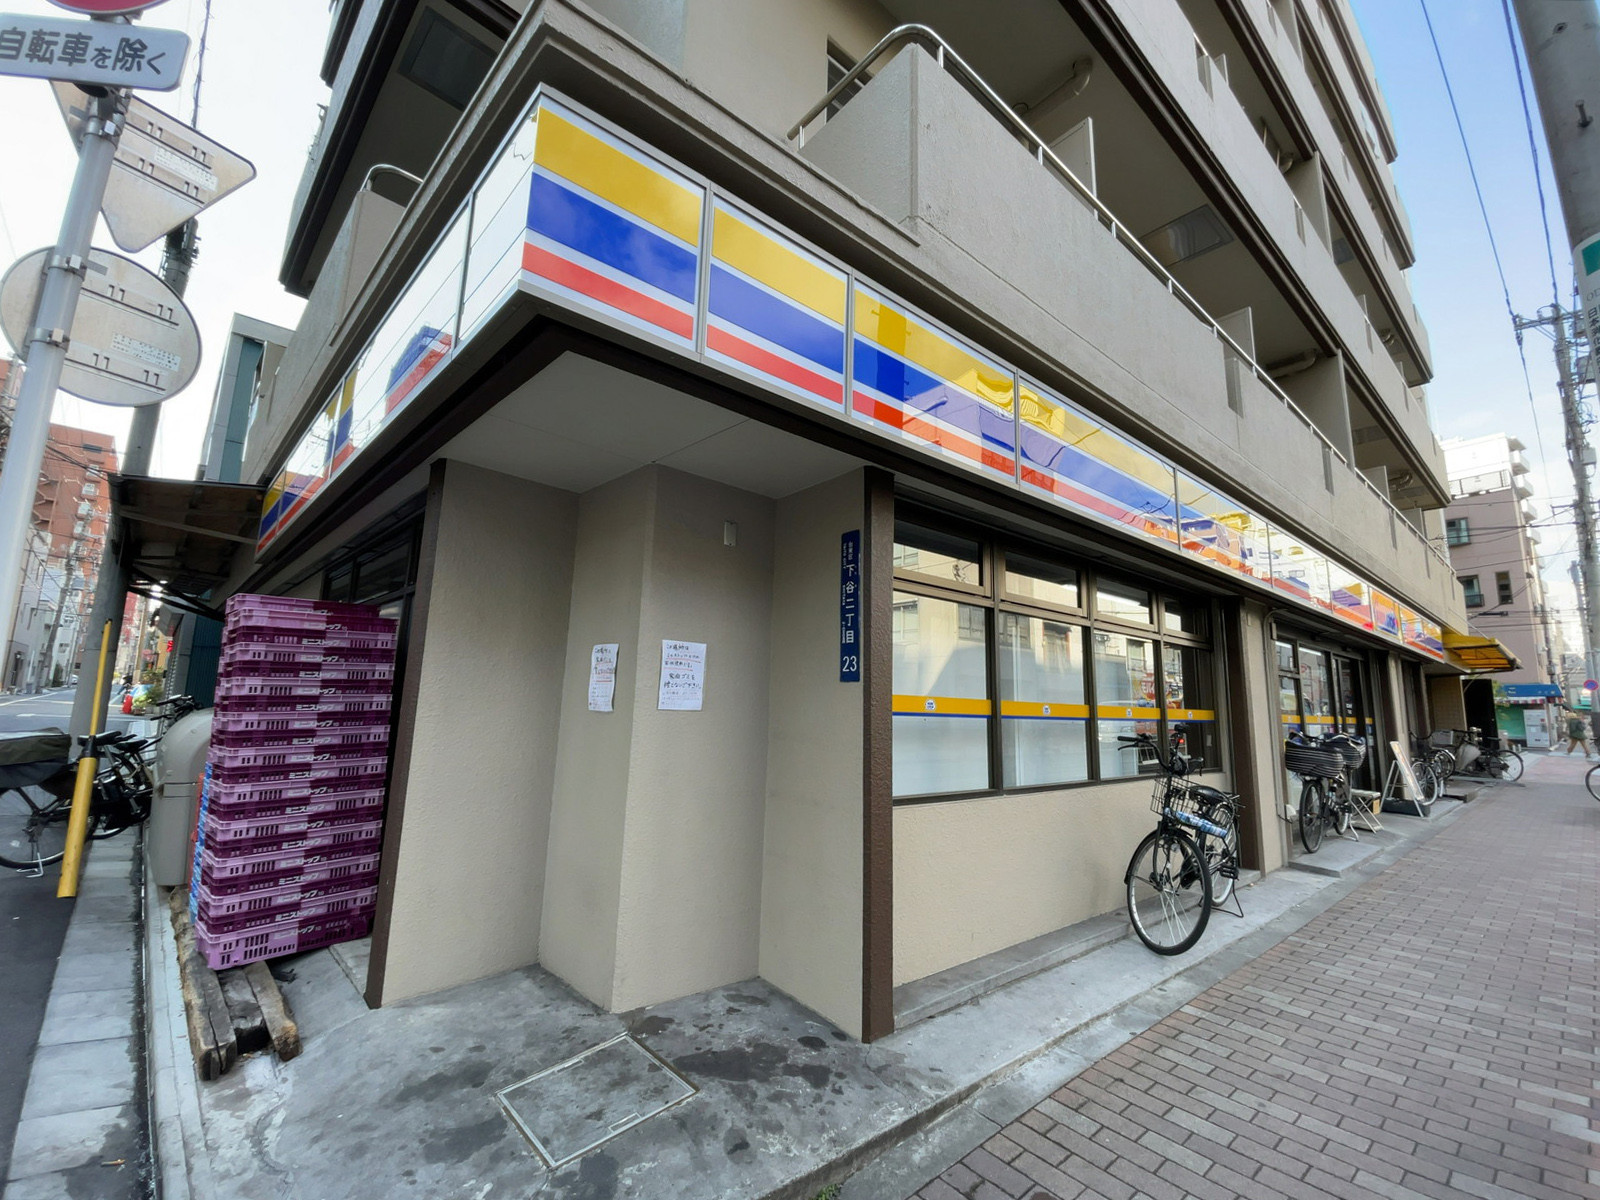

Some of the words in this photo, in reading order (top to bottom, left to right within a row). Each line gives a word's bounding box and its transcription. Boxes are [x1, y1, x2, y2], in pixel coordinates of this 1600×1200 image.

[0, 27, 166, 75] 自転車を除く
[846, 564, 855, 644] 下谷二丁目
[842, 655, 857, 672] 23
[279, 872, 319, 885] ミニストップ
[275, 908, 316, 921] ミニストップ
[274, 925, 315, 939] ミニストップ
